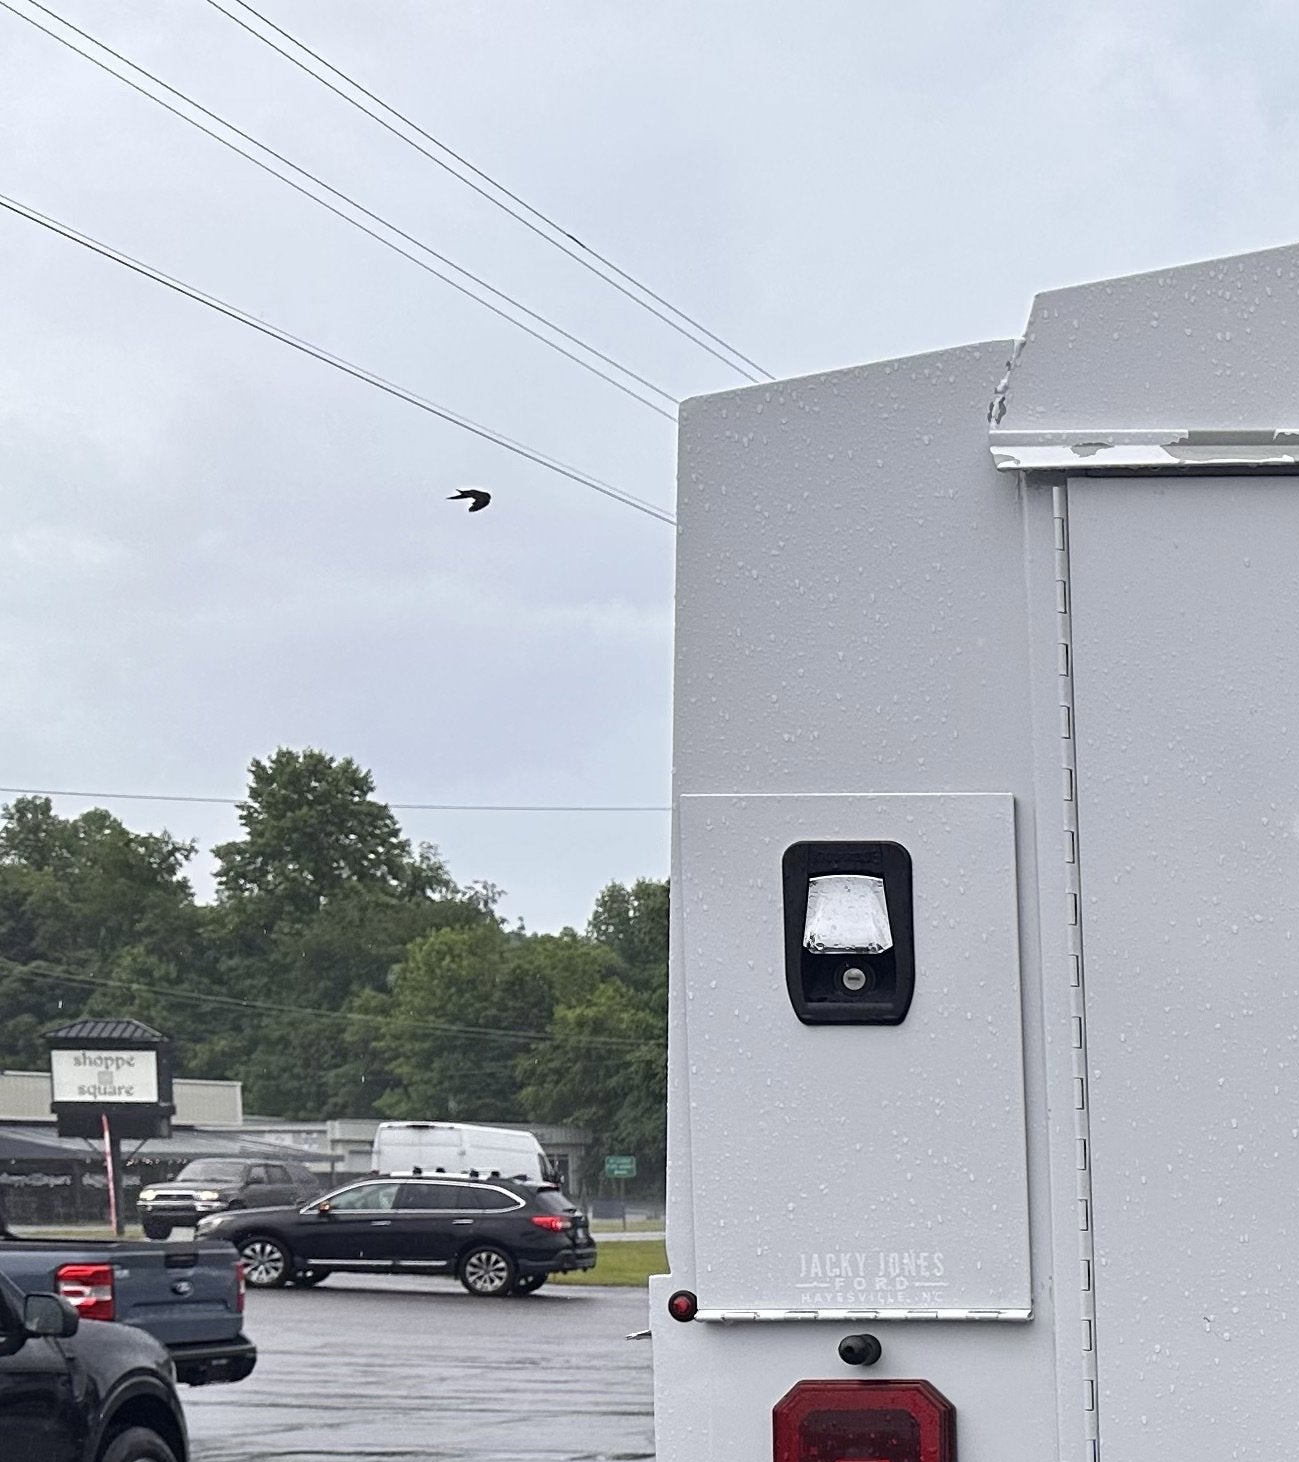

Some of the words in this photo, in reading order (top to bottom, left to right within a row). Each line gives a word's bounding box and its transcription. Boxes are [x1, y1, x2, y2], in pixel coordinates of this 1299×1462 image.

[73, 1050, 135, 1070] shoppe
[78, 1084, 134, 1099] square
[800, 1253, 866, 1277] JACKY
[878, 1251, 945, 1277] JONES
[835, 1277, 908, 1290] FORD
